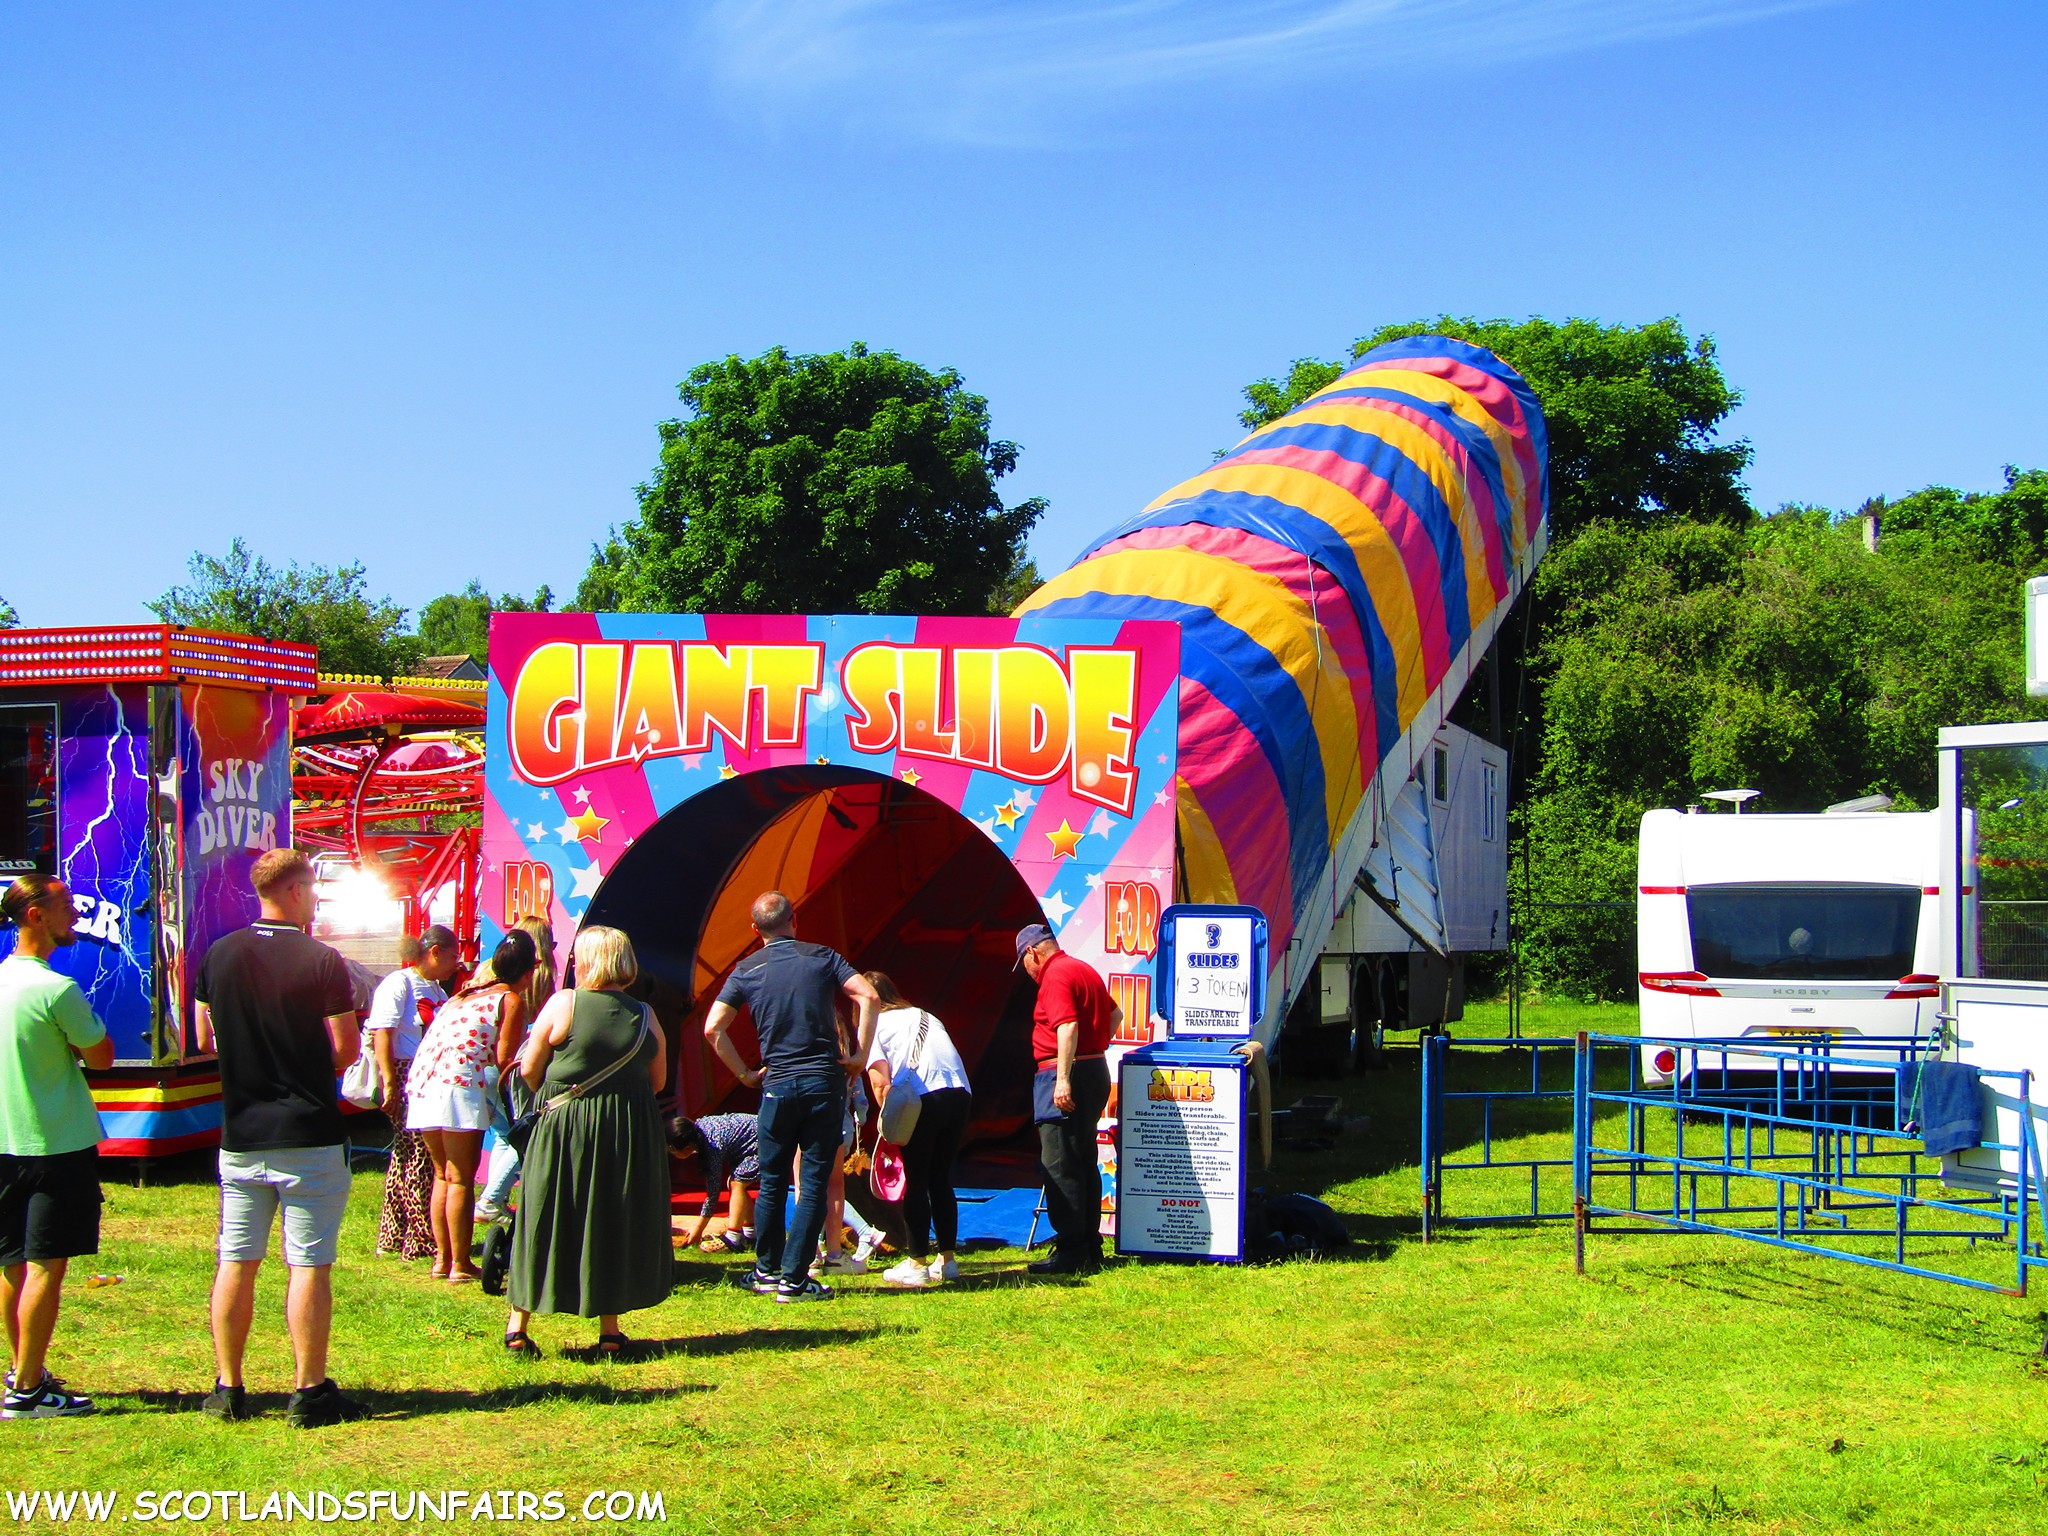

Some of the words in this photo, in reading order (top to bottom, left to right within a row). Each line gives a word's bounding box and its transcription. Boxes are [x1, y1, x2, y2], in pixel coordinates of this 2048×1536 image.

[509, 638, 825, 786] GIANT
[841, 643, 1142, 818] SLIDE
[210, 758, 264, 803] SKY
[196, 805, 276, 855] DIVER
[504, 860, 553, 928] FOR
[1105, 879, 1161, 962] FOR
[1206, 924, 1222, 949] 3
[1187, 953, 1239, 969] SLIDES
[1188, 977, 1199, 993] 3
[1207, 978, 1245, 998] TOKEN
[1109, 973, 1154, 1046] ALL
[1185, 1010, 1209, 1018] SLIDES
[1210, 1010, 1225, 1019] ARE
[1226, 1011, 1240, 1019] NOT
[1185, 1019, 1239, 1027] TRANSFERABLE
[1151, 1069, 1212, 1087] SLIDE
[1147, 1084, 1215, 1102] RULES
